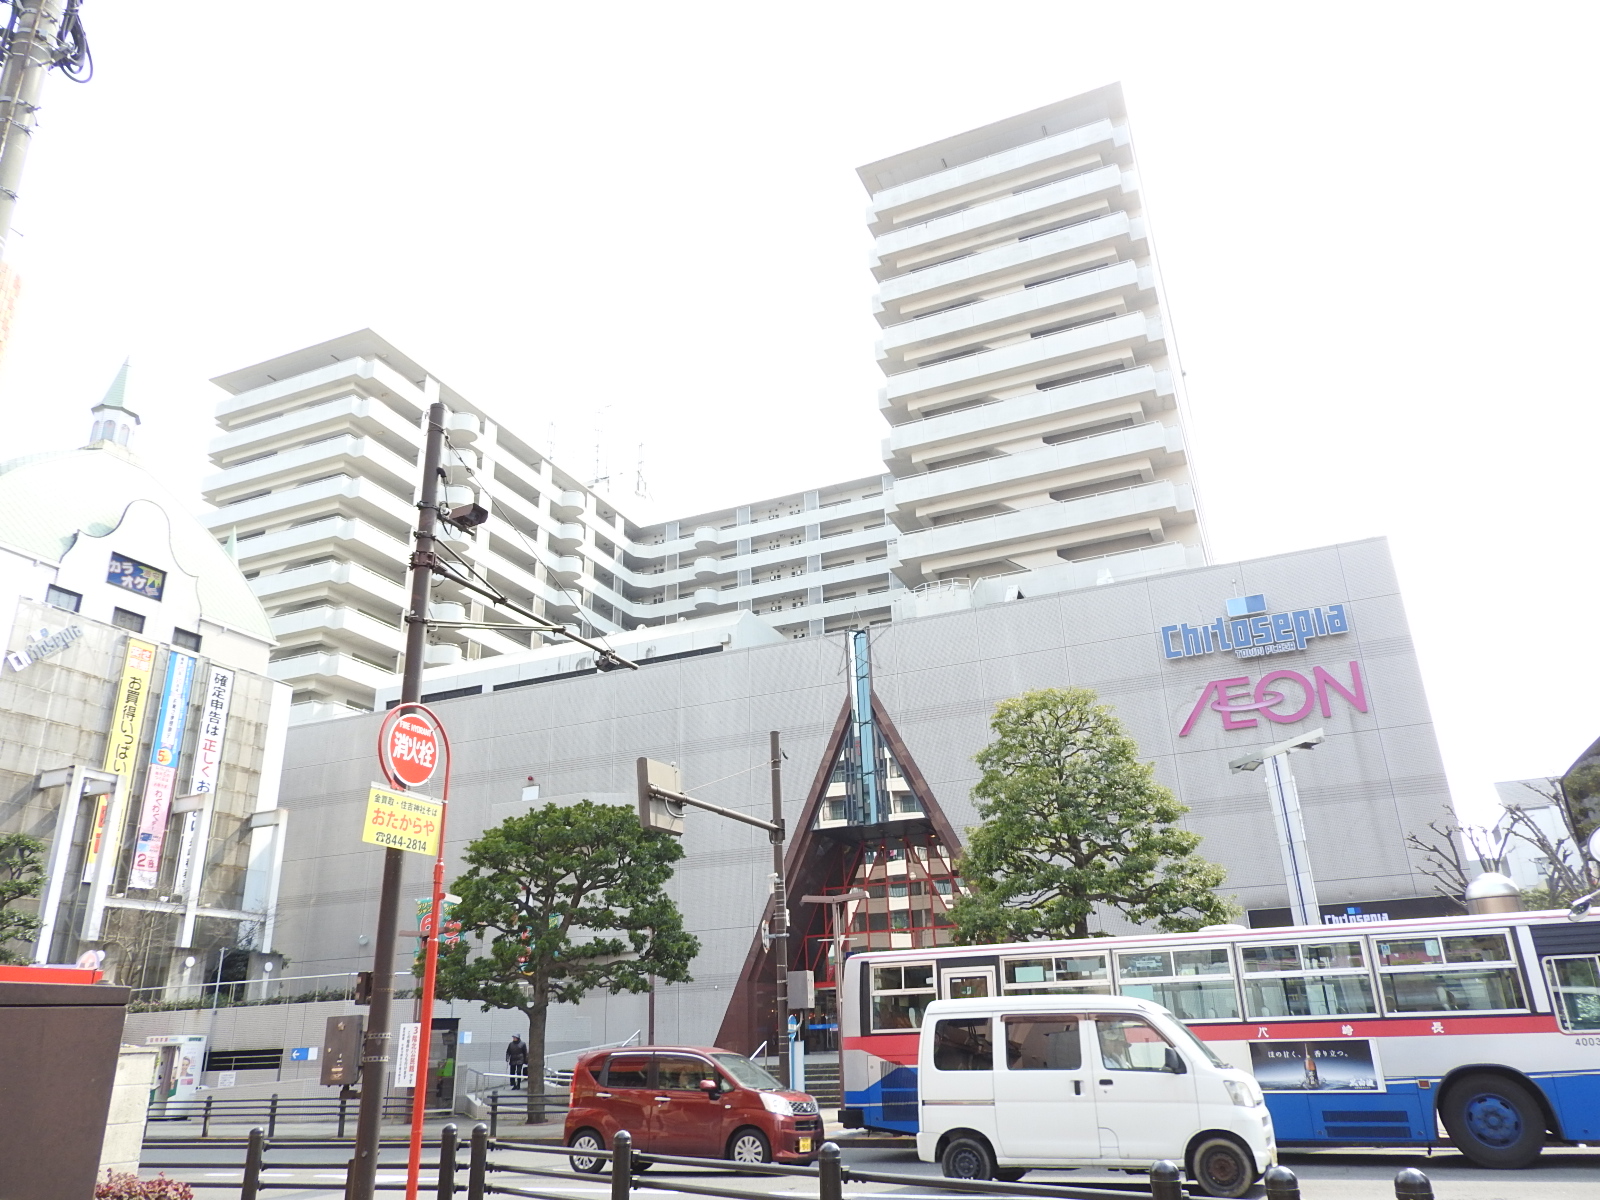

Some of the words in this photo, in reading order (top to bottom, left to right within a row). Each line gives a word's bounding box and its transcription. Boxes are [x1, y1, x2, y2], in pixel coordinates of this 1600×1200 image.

[109, 560, 134, 575] カラ
[121, 575, 147, 589] オケ
[1160, 603, 1349, 660] Chitosepia
[1235, 648, 1265, 659] TOWN
[1265, 641, 1296, 656] PLAZA
[1178, 660, 1369, 738] AEON
[399, 720, 411, 731] FIRE
[411, 724, 432, 737] HYDRANT
[392, 730, 435, 768] 消火栓
[373, 793, 438, 817] 金買取・住吉神社そば
[371, 808, 435, 837] おたからや
[385, 833, 427, 852] 844-2814
